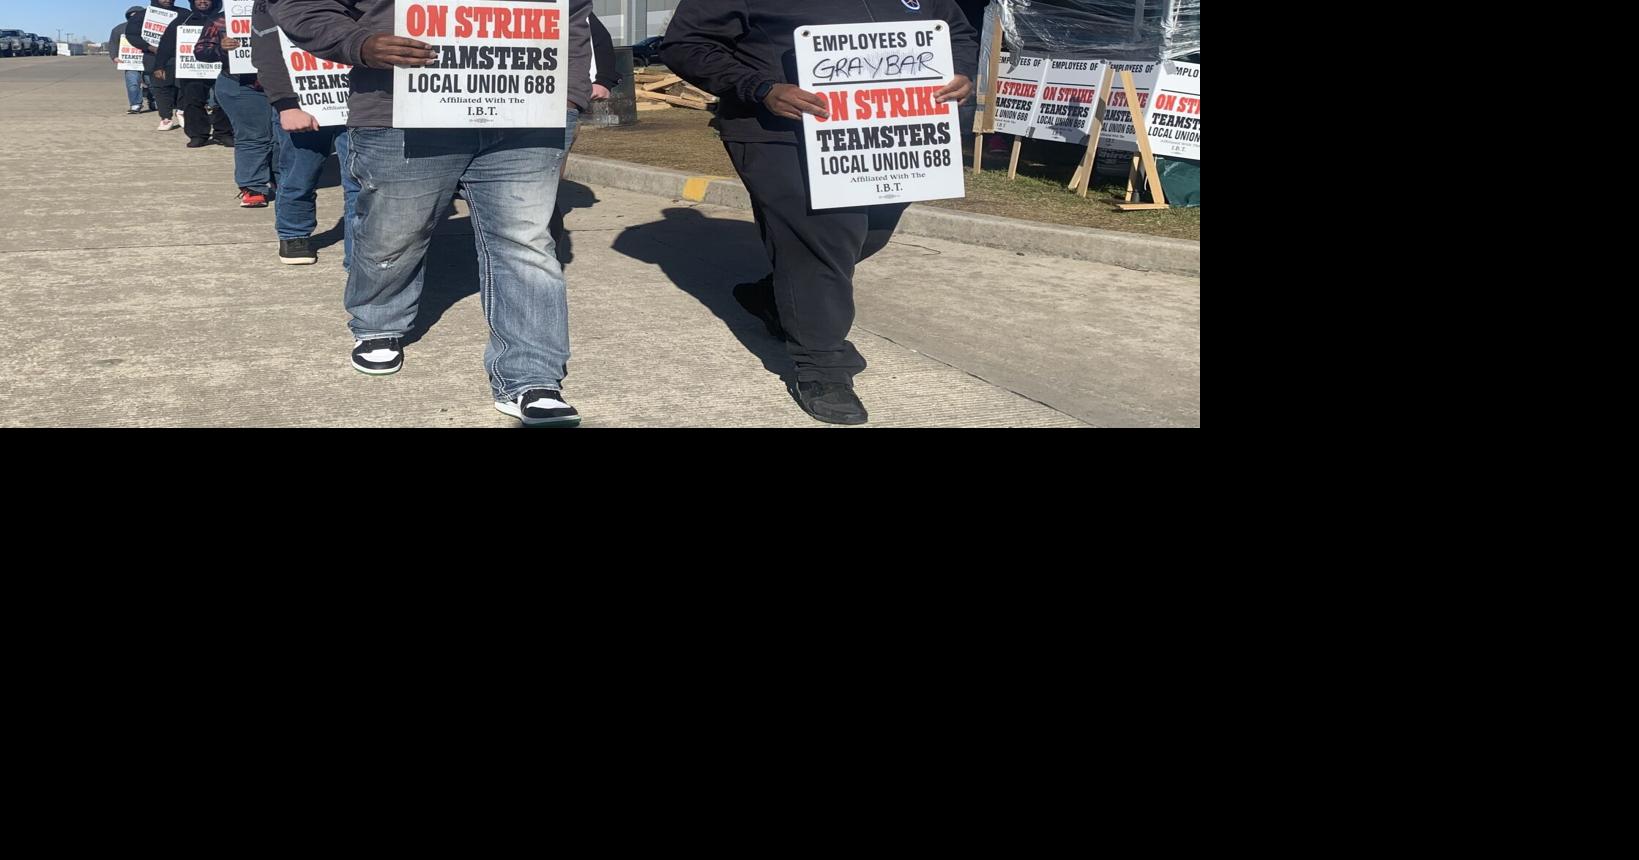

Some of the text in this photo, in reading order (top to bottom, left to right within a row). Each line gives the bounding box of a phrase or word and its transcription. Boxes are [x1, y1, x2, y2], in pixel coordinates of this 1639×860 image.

[232, 20, 250, 34] ON
[406, 4, 560, 40] ON STRIKE
[812, 30, 934, 52] EMPLOYEES OF
[180, 44, 192, 53] ON
[235, 50, 250, 58] LOC
[290, 52, 318, 71] ON
[410, 45, 558, 70] EAMSTERS
[1033, 59, 1042, 67] OF
[812, 52, 944, 81] GRAYBAR
[1052, 61, 1098, 71] EMPLOYEES OF
[1145, 64, 1154, 73] OF
[408, 73, 555, 94] LOCAL UNION 688
[1002, 82, 1038, 98] STRIKE
[300, 92, 334, 106] LOCAL
[1043, 86, 1058, 100] ON
[1058, 88, 1095, 104] STRIKE
[1156, 94, 1176, 111] ON
[468, 106, 498, 116] I.B.T.
[1016, 112, 1028, 121] 688
[1040, 103, 1090, 118] TEAMSTERS
[1037, 115, 1054, 125] LOCAL
[1054, 116, 1072, 127] UNION
[816, 122, 950, 152] TEAMSTERS
[1148, 126, 1172, 138] LOCAL
[820, 148, 951, 176] LOCAL UNION 688
[850, 174, 888, 184] Affiliated
[890, 172, 910, 181] With
[876, 183, 903, 192] I.B.T.
